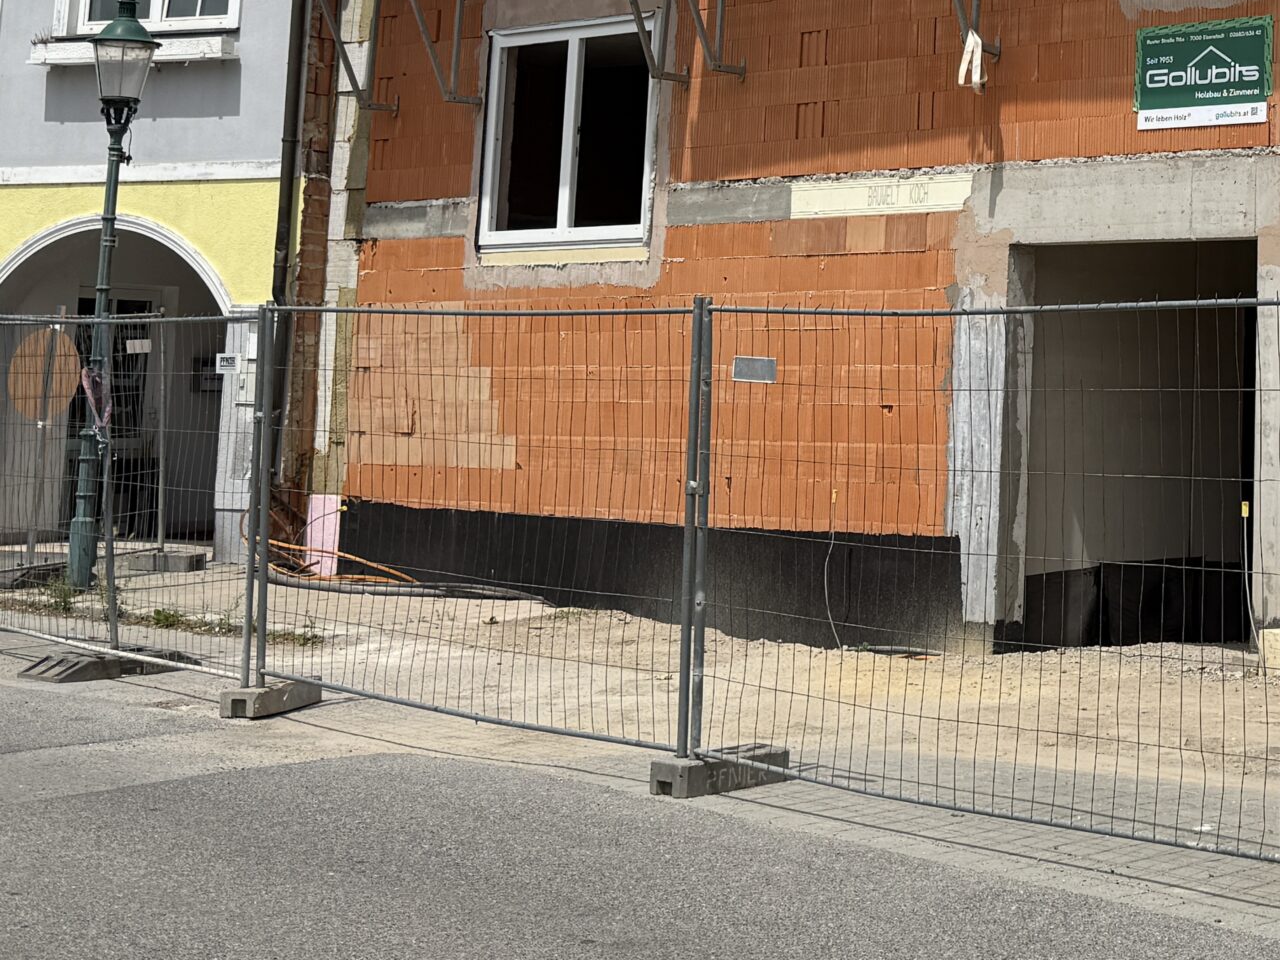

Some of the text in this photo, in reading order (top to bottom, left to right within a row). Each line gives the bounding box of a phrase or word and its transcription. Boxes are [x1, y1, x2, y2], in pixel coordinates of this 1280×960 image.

[1146, 56, 1174, 65] Seit 1953
[1146, 61, 1260, 88] Gollubits
[1195, 86, 1260, 99] Holzbau & Zimmerei
[1144, 115, 1154, 123] Wir
[1215, 110, 1249, 120] gollubits.at
[909, 183, 929, 204] KOCH
